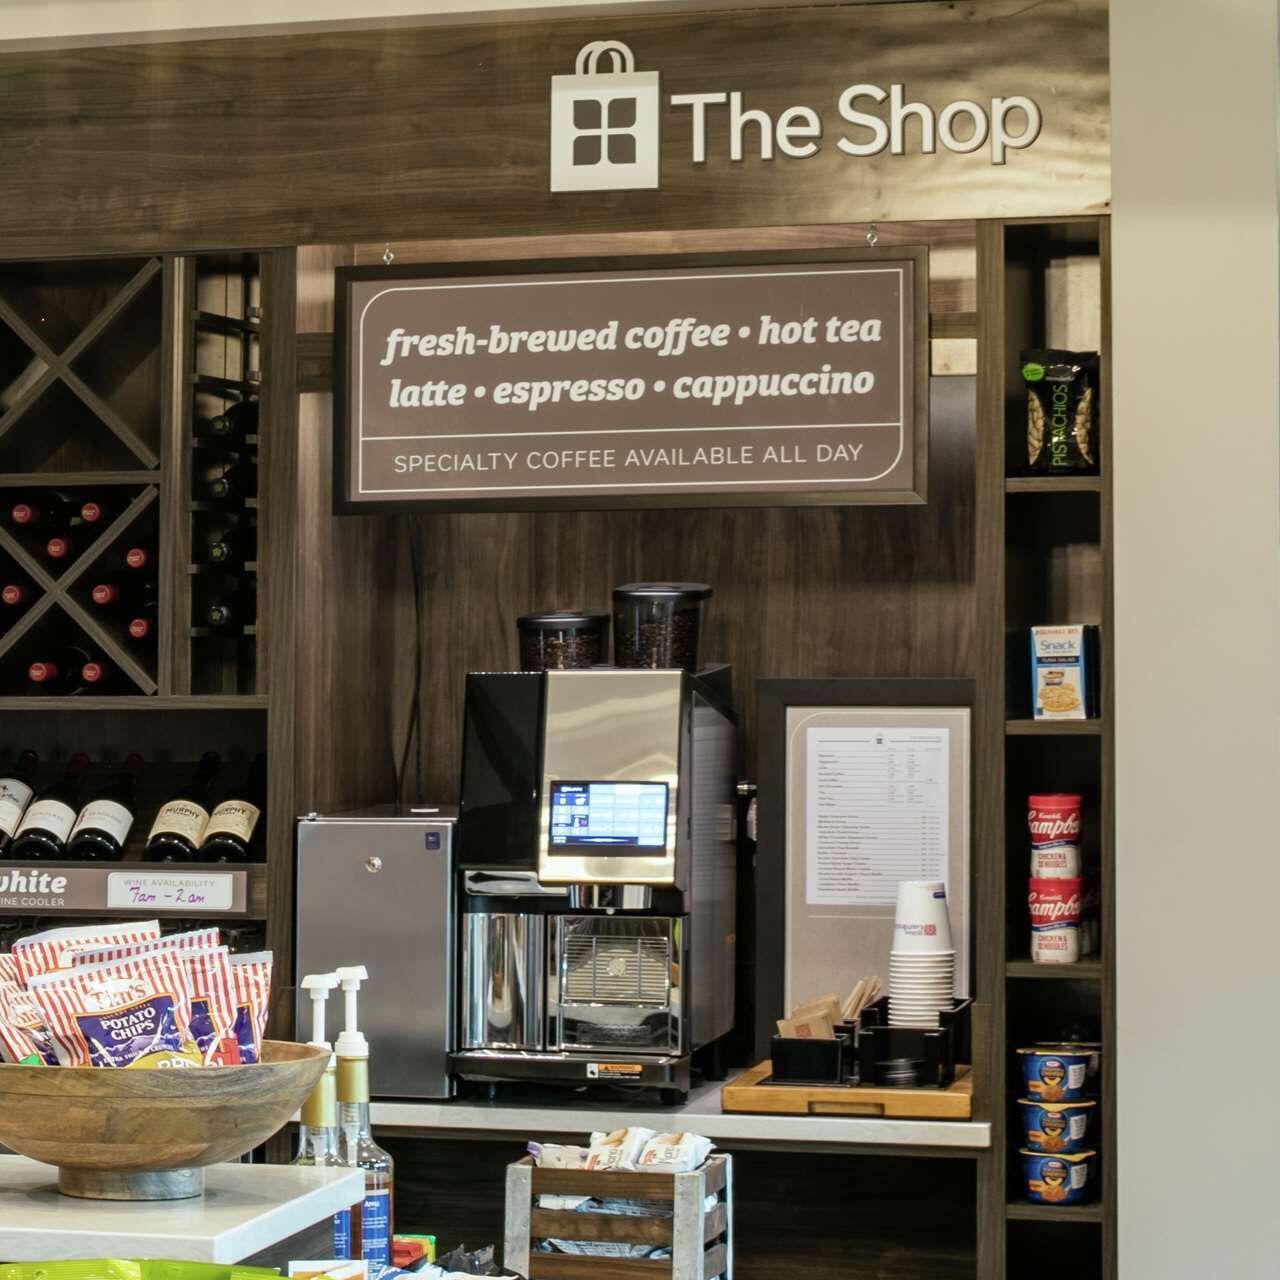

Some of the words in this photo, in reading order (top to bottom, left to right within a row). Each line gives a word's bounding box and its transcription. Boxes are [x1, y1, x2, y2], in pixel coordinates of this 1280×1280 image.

[670, 92, 822, 163] The
[837, 83, 1043, 166] Shop
[380, 320, 617, 366] fresh-brewed
[625, 318, 730, 357] coffee
[758, 314, 818, 346] hot
[825, 315, 881, 343] tea
[389, 378, 467, 408] latte
[493, 375, 645, 412] espresso
[673, 363, 875, 406] cappuccino
[1052, 383, 1069, 466] PISTACHIOS
[394, 452, 518, 473] SPECIALTY
[526, 449, 616, 471] COFFEE
[624, 445, 753, 467] AVAILABLE
[762, 444, 808, 465] ALL
[816, 442, 864, 464] DAY
[1039, 639, 1077, 651] Snack
[166, 806, 201, 821] MURPHY
[123, 879, 149, 888] WINE
[151, 879, 216, 888] AVAILABILITY
[129, 886, 156, 903] 7am
[20, 897, 65, 908] COOLER
[101, 1008, 156, 1031] POTATO
[111, 1020, 155, 1041] CHIPS
